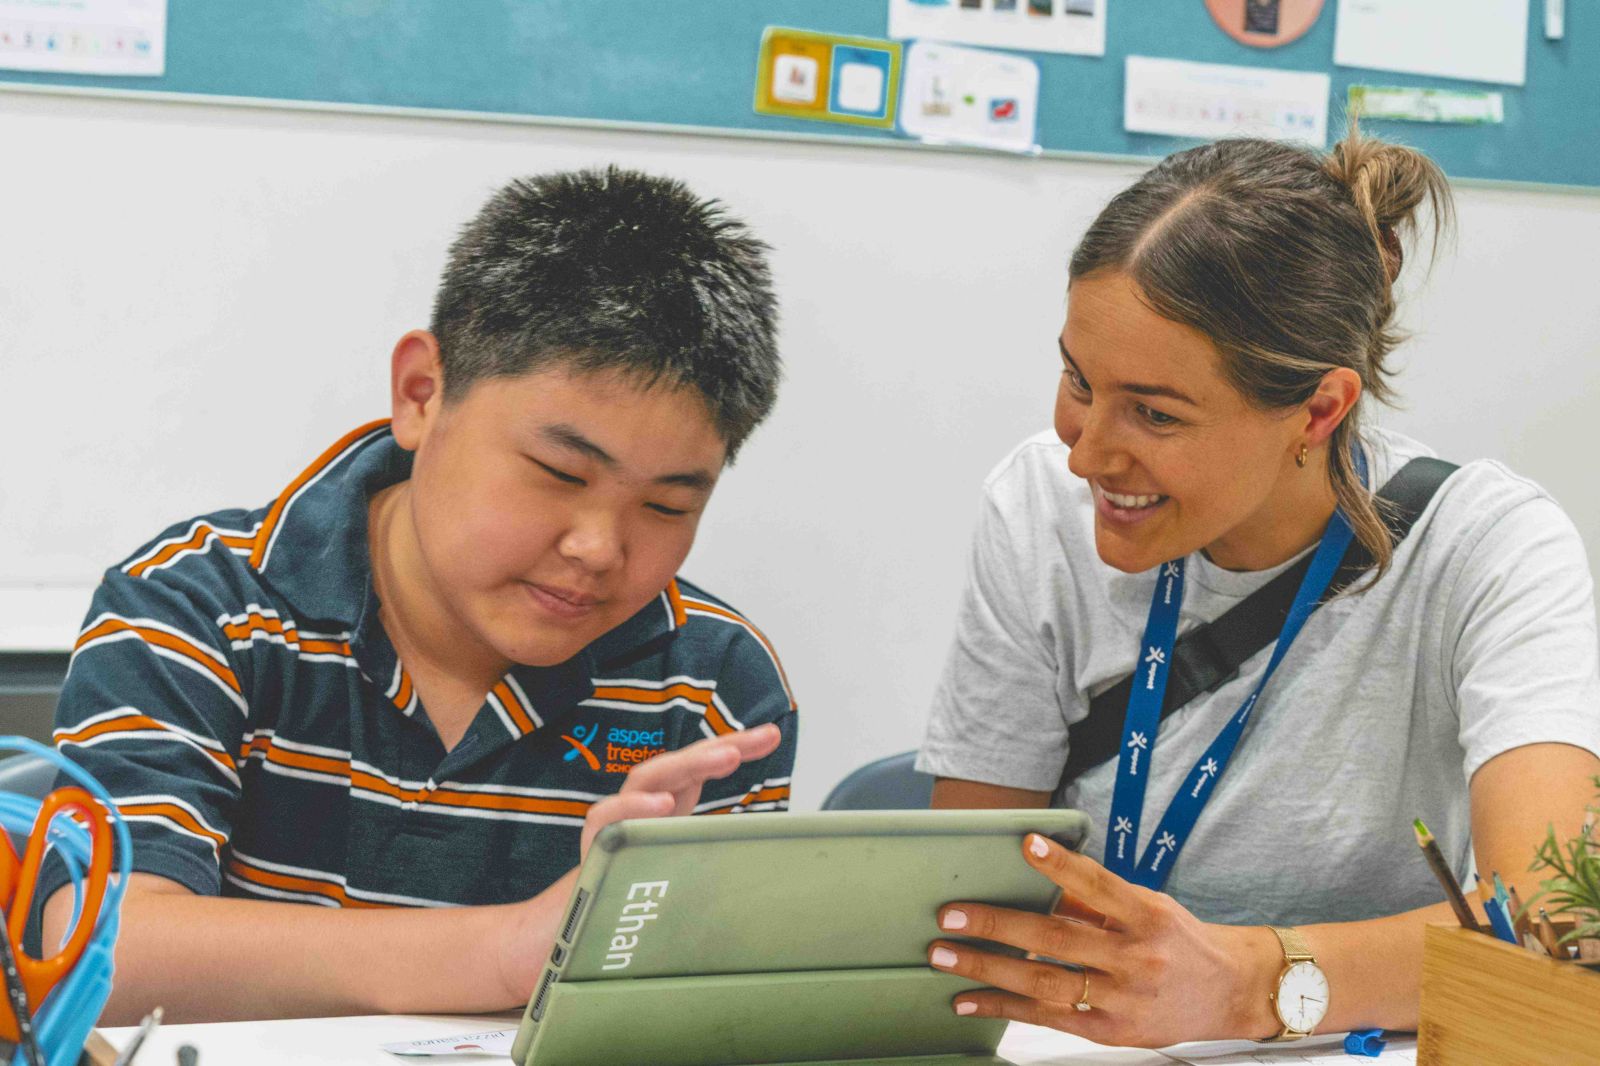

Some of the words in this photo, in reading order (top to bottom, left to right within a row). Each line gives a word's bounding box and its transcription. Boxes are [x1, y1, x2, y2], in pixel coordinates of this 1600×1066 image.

[608, 727, 665, 747] aspect
[607, 742, 667, 763] treeto
[602, 880, 669, 970] Ethan
